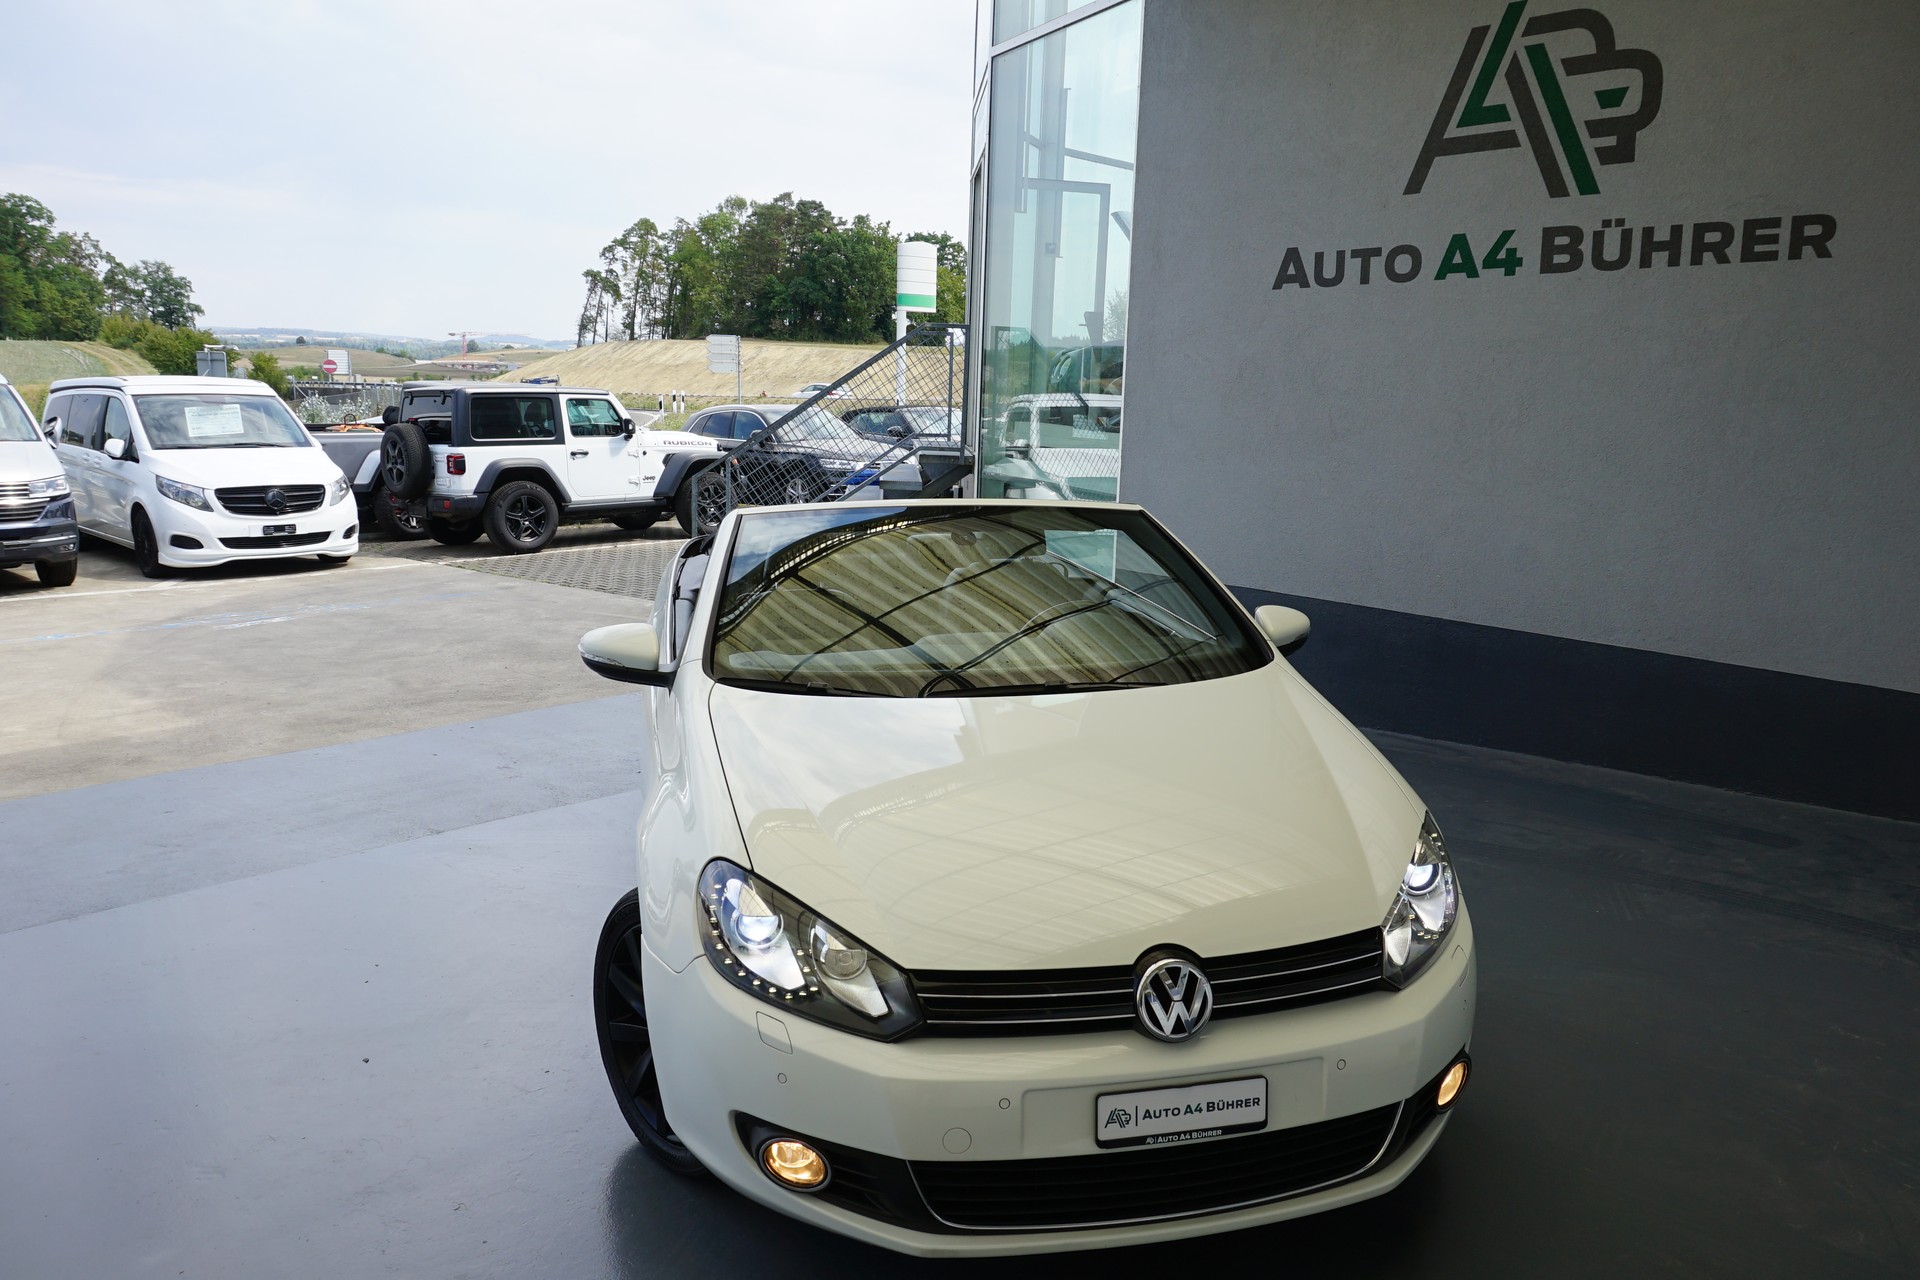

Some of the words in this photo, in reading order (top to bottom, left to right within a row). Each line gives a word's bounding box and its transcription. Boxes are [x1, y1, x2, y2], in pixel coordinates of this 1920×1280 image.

[1272, 244, 1423, 290] AUTO
[1434, 229, 1523, 280] A4
[1540, 213, 1838, 275] BÜHRER
[1142, 963, 1209, 1038] VW
[1142, 1107, 1180, 1120] AUTO
[1184, 1103, 1203, 1116] A4
[1206, 1097, 1260, 1112] BÜHRER
[1157, 1135, 1179, 1143] AUTO
[1180, 1132, 1191, 1140] A4
[1192, 1129, 1222, 1139] BÜHRER
